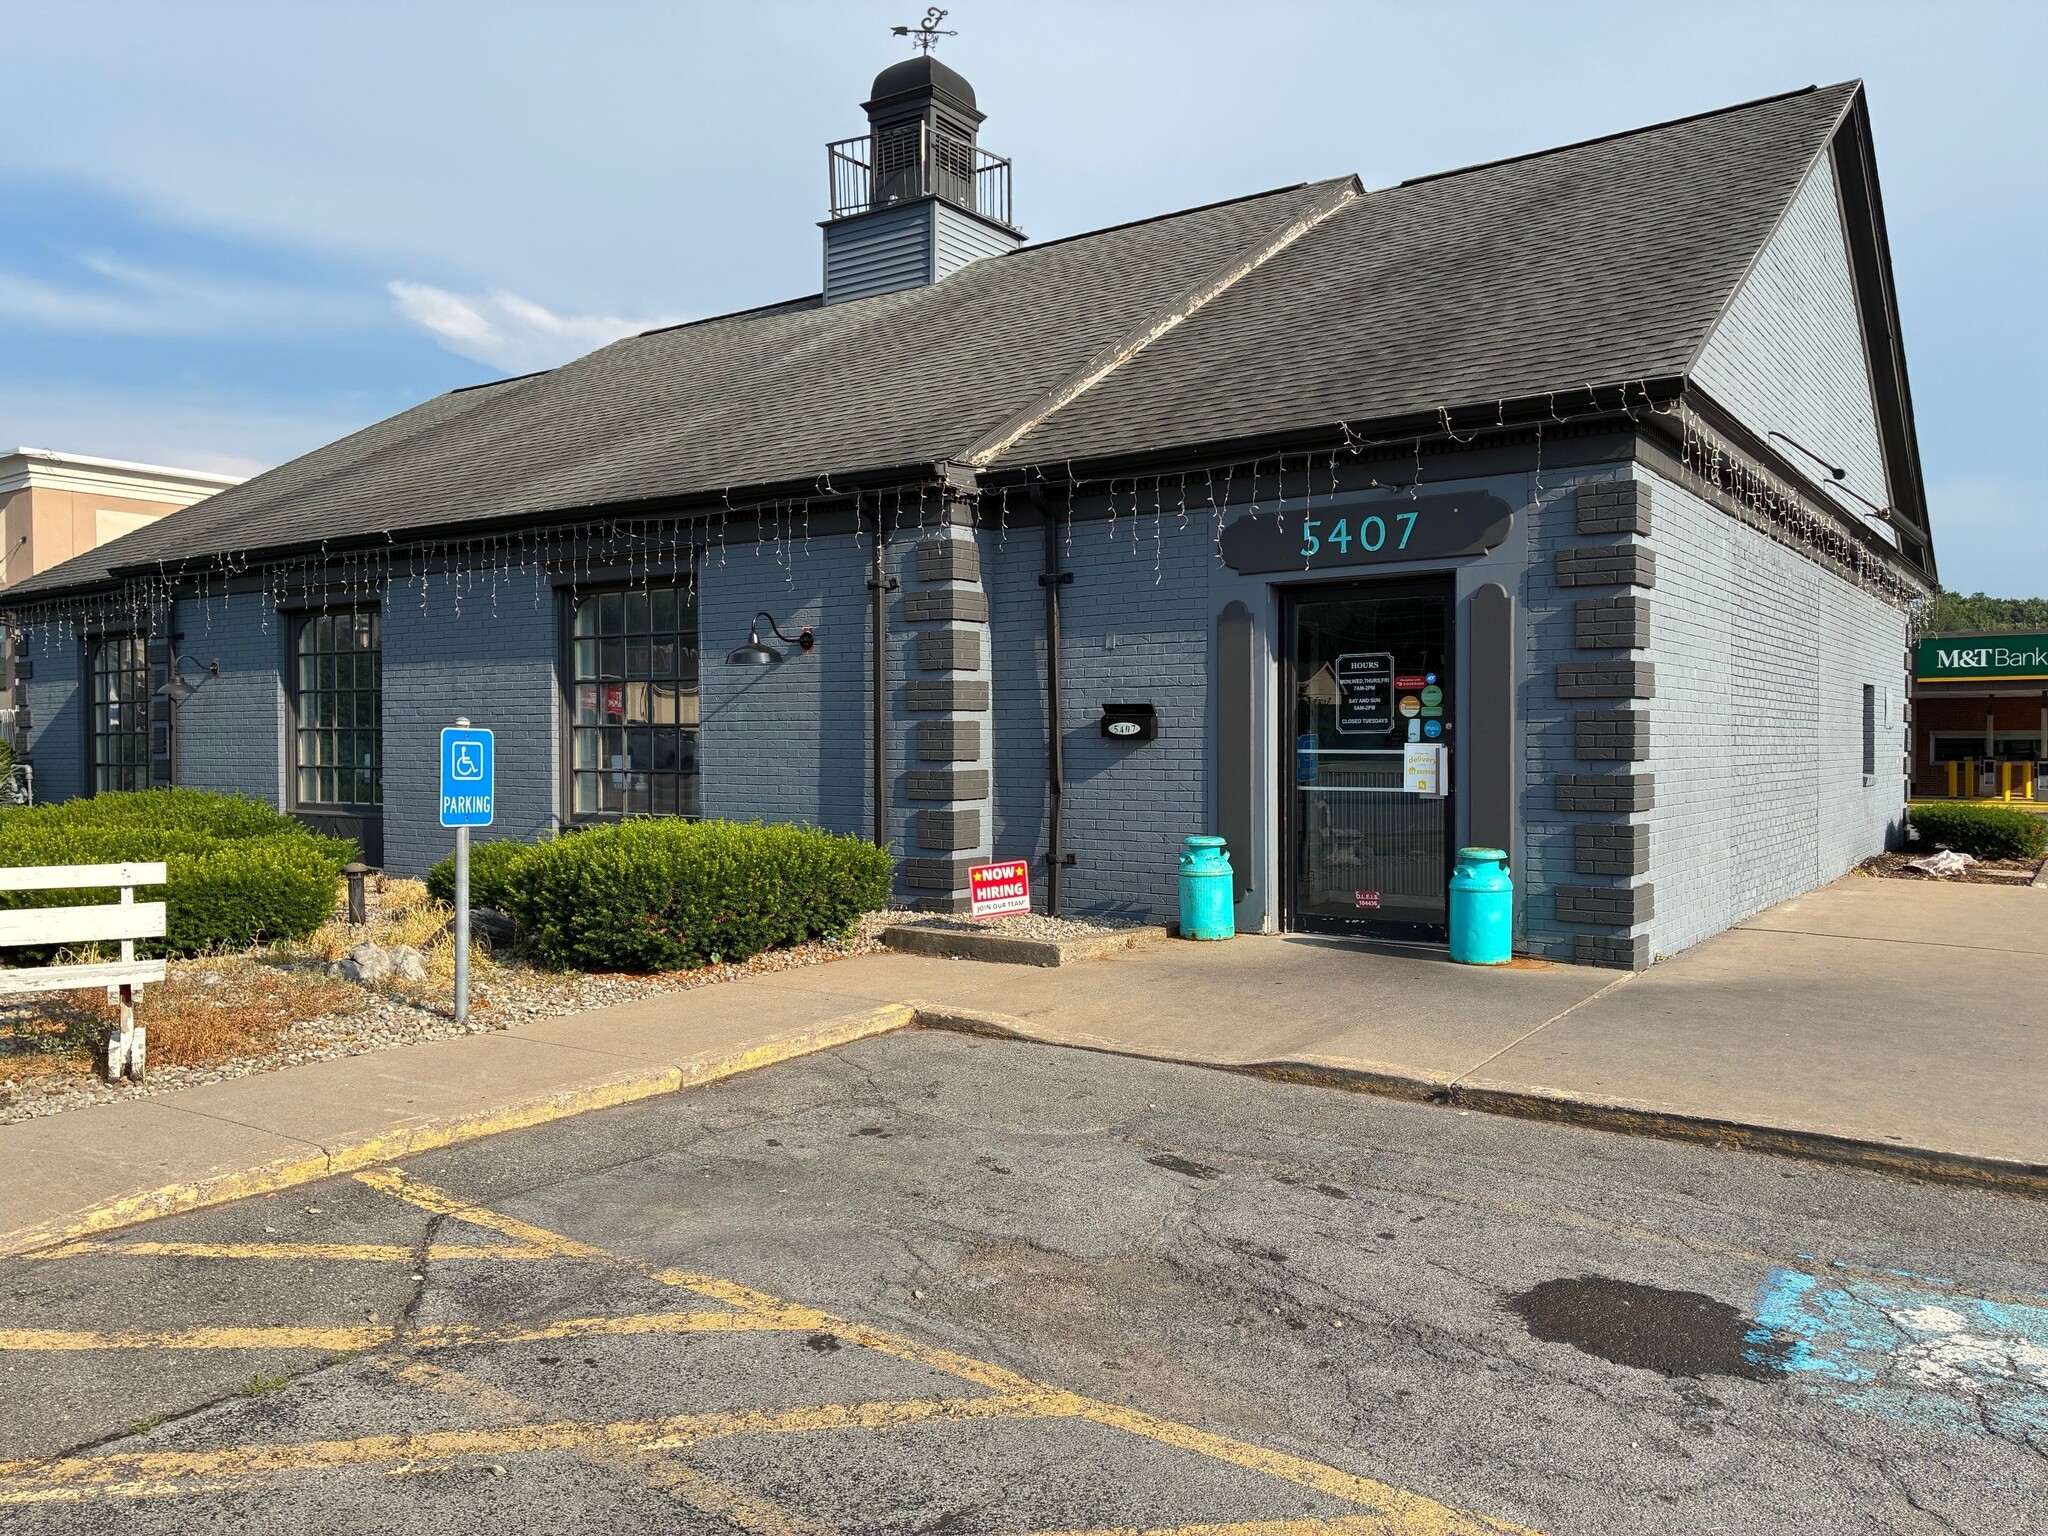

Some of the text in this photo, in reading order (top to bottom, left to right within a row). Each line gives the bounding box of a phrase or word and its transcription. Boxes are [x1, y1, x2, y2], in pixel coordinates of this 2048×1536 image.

[1300, 511, 1419, 557] 5407
[1936, 647, 2048, 668] M&T Bank
[1114, 724, 1136, 733] 5407
[1408, 756, 1436, 765] delivery
[443, 796, 490, 814] PARKING
[982, 866, 1014, 882] NOW
[976, 883, 1024, 900] HIRING
[977, 904, 991, 913] JOIN
[993, 902, 1007, 910] OUR
